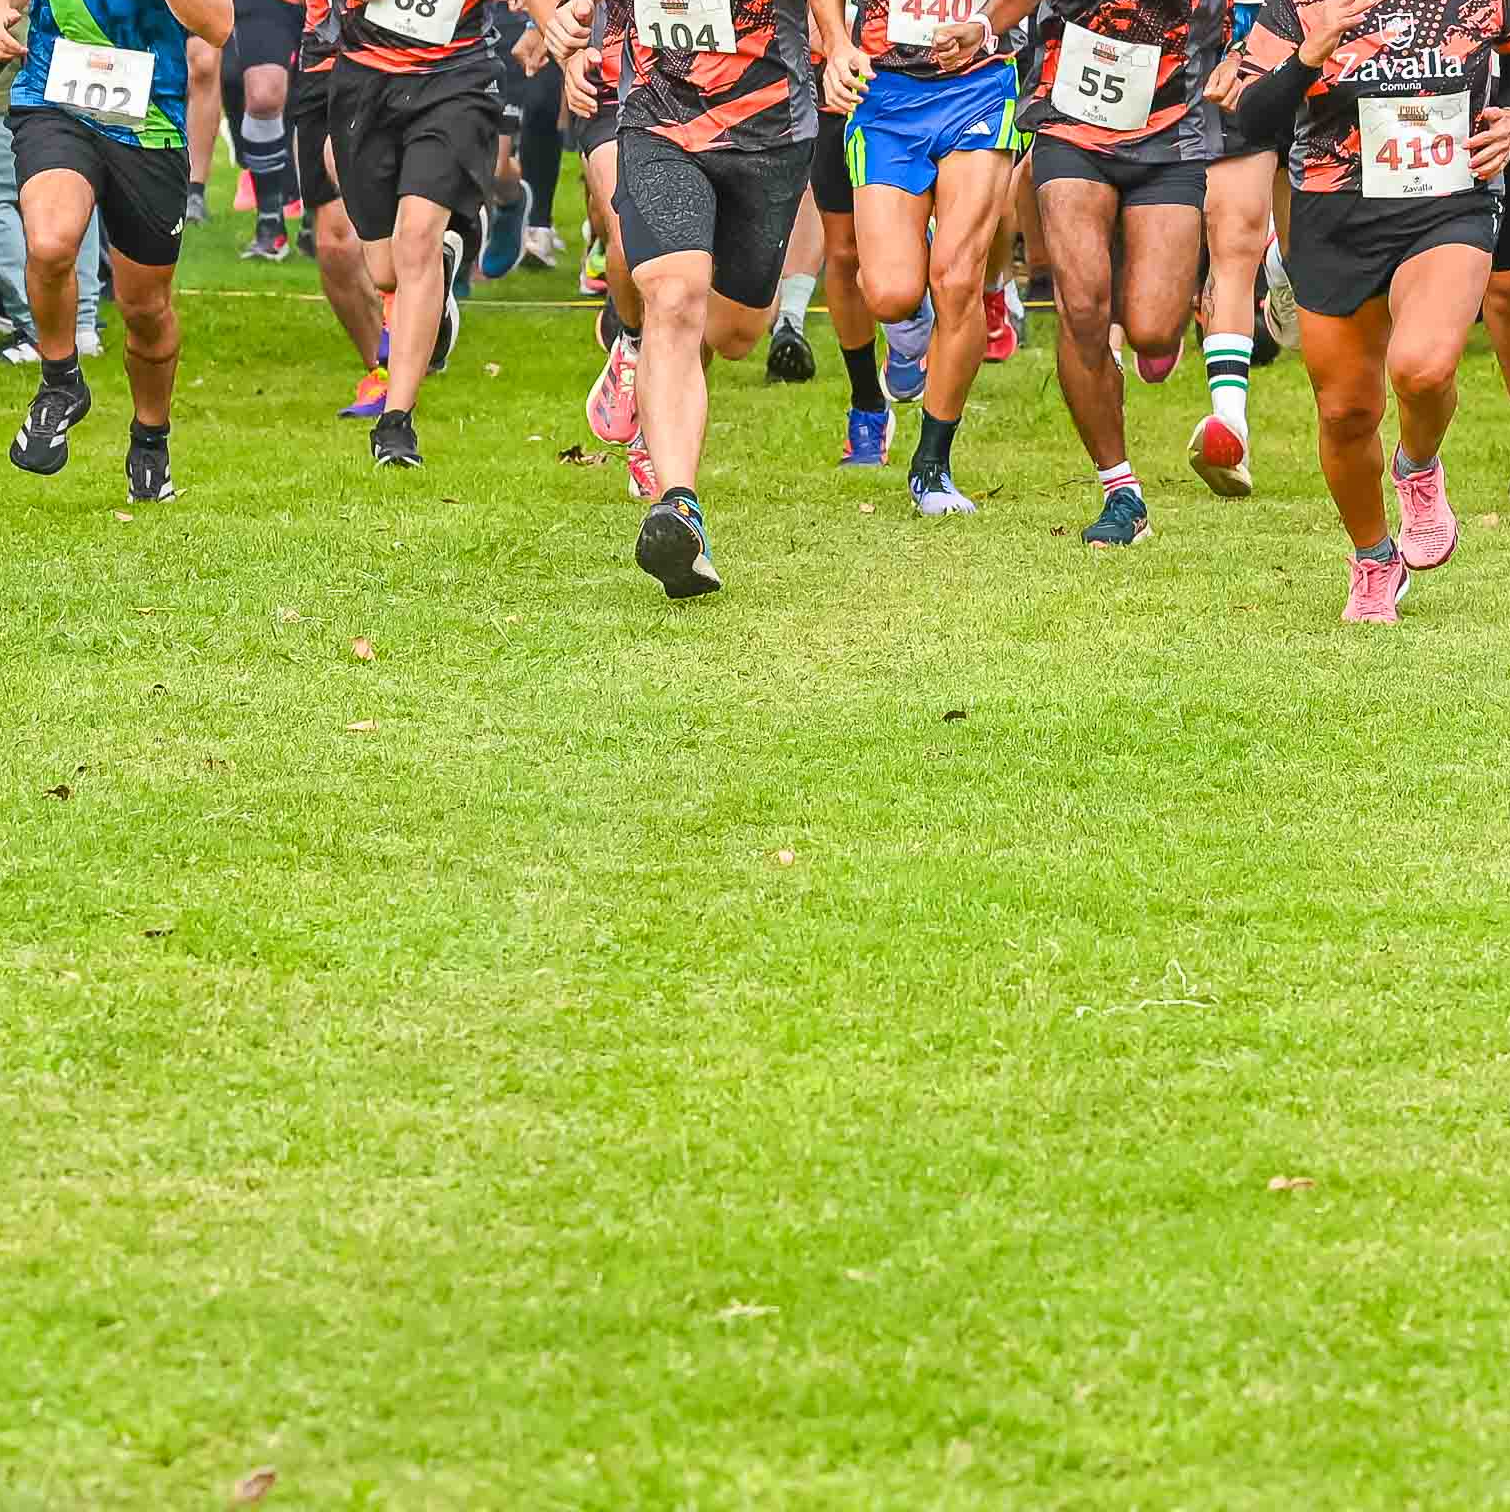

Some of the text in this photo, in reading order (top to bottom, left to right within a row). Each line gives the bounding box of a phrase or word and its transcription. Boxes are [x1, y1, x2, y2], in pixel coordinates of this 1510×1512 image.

[648, 22, 720, 52] 104
[1337, 47, 1464, 82] Zavalla
[62, 79, 132, 112] 102
[1078, 66, 1126, 104] 55
[1380, 80, 1422, 92] Comuna
[1375, 133, 1454, 171] 410
[1402, 183, 1433, 194] Zavalla
